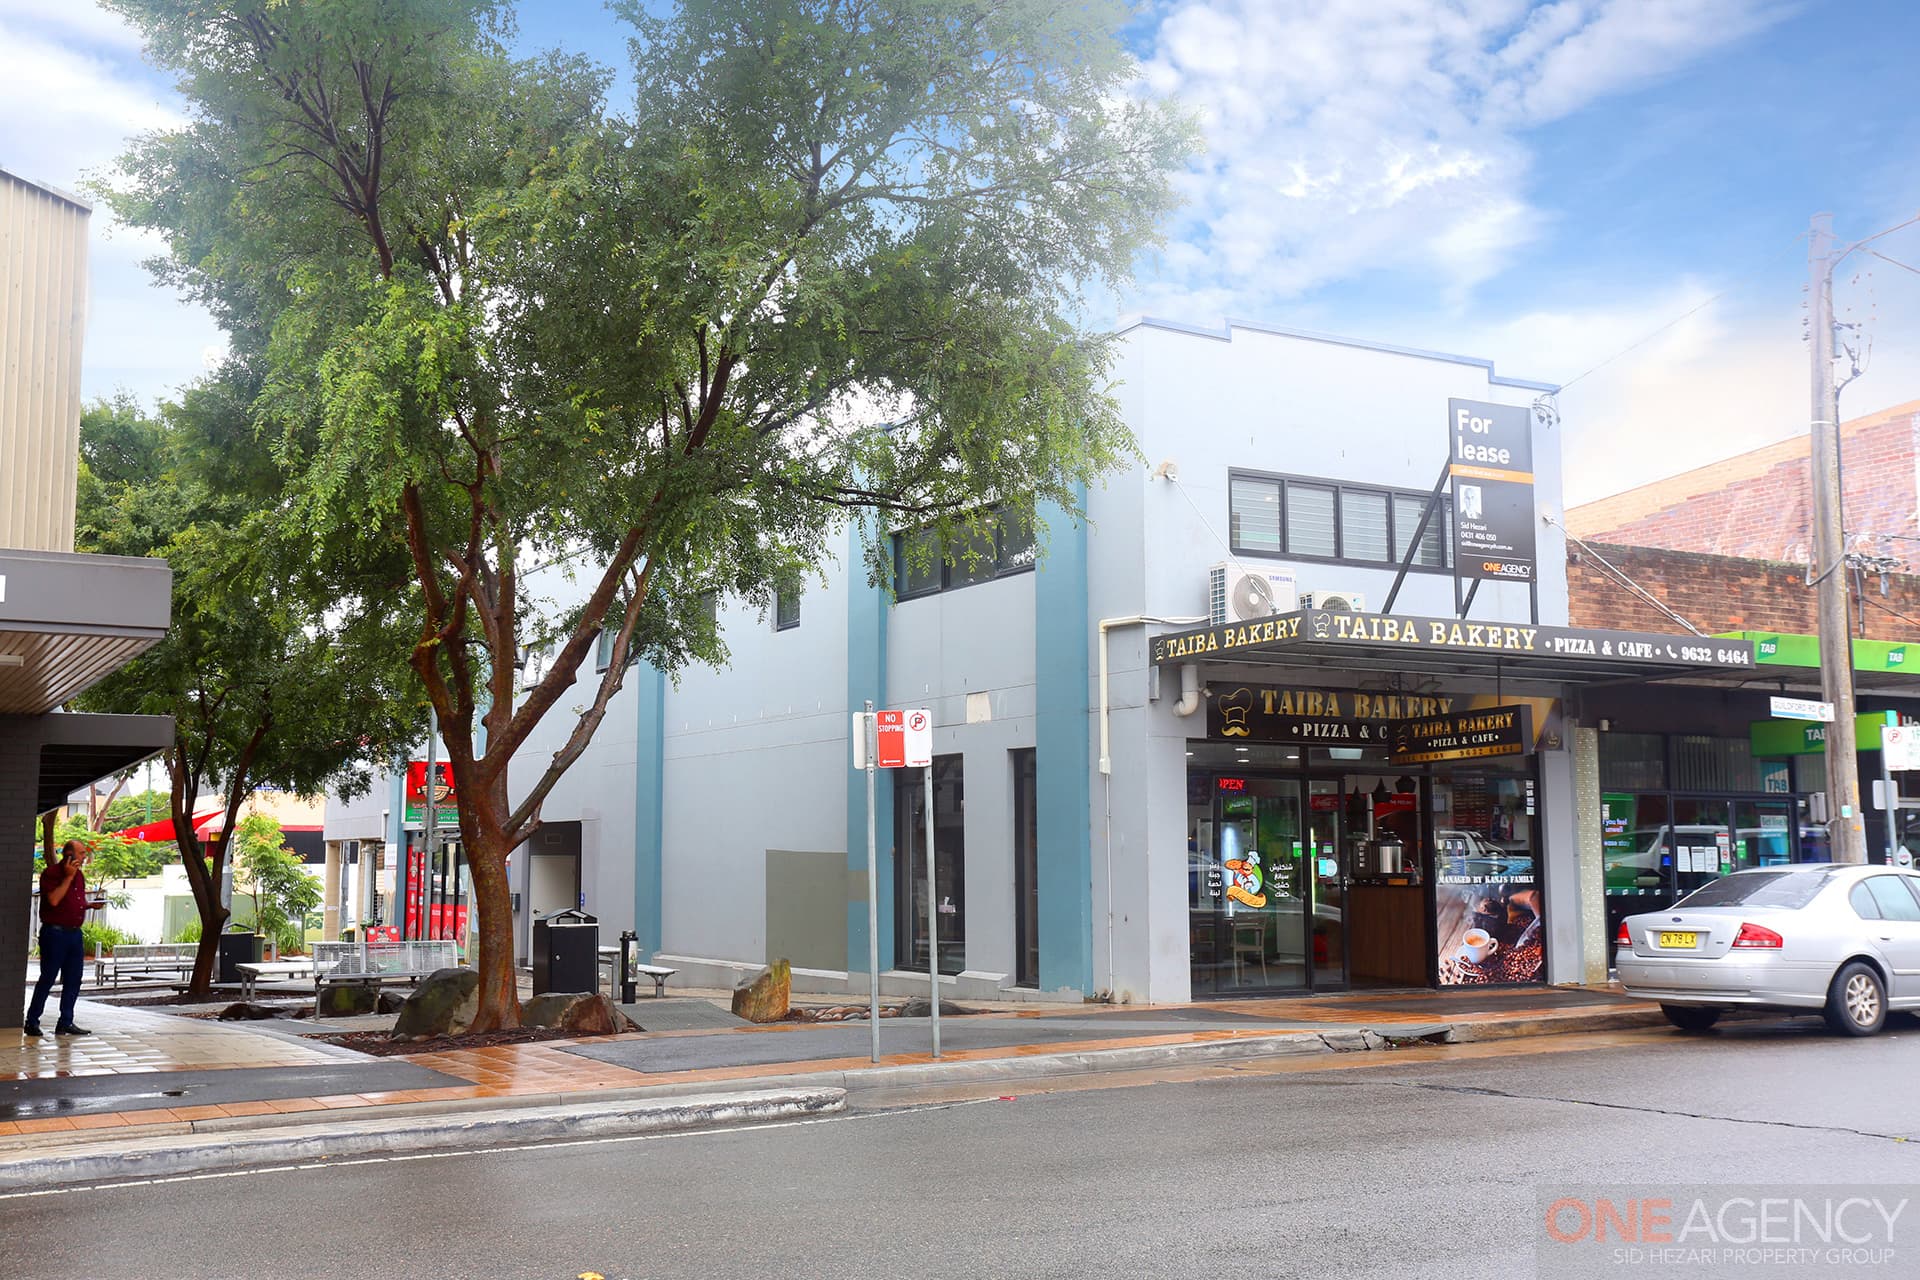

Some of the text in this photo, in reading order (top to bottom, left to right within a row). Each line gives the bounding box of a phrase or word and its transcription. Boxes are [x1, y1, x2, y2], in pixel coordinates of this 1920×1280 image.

[1457, 409, 1493, 434] For
[1457, 436, 1511, 465] lease
[1268, 575, 1293, 583] SAMSUNG
[1166, 616, 1301, 658] TAIBA BAKERY
[1334, 615, 1749, 665] TAIBA BAKERY PIZZA & CAFE 9632 6464
[1760, 642, 1777, 654] TAB
[1888, 652, 1904, 663] TAB
[1260, 689, 1454, 719] TAIBA BAKERY
[885, 714, 896, 722] NO
[1412, 712, 1514, 738] TAIBA BAKERY
[878, 724, 904, 733] STOPPING
[1302, 722, 1350, 738] PIZZA
[1359, 724, 1369, 738] &
[1433, 733, 1495, 747] PIZZA & CAFE
[1768, 779, 1787, 791] TAB
[1439, 875, 1471, 884] MANAGED
[1473, 875, 1483, 883] BY
[1510, 875, 1535, 883] FAMILY
